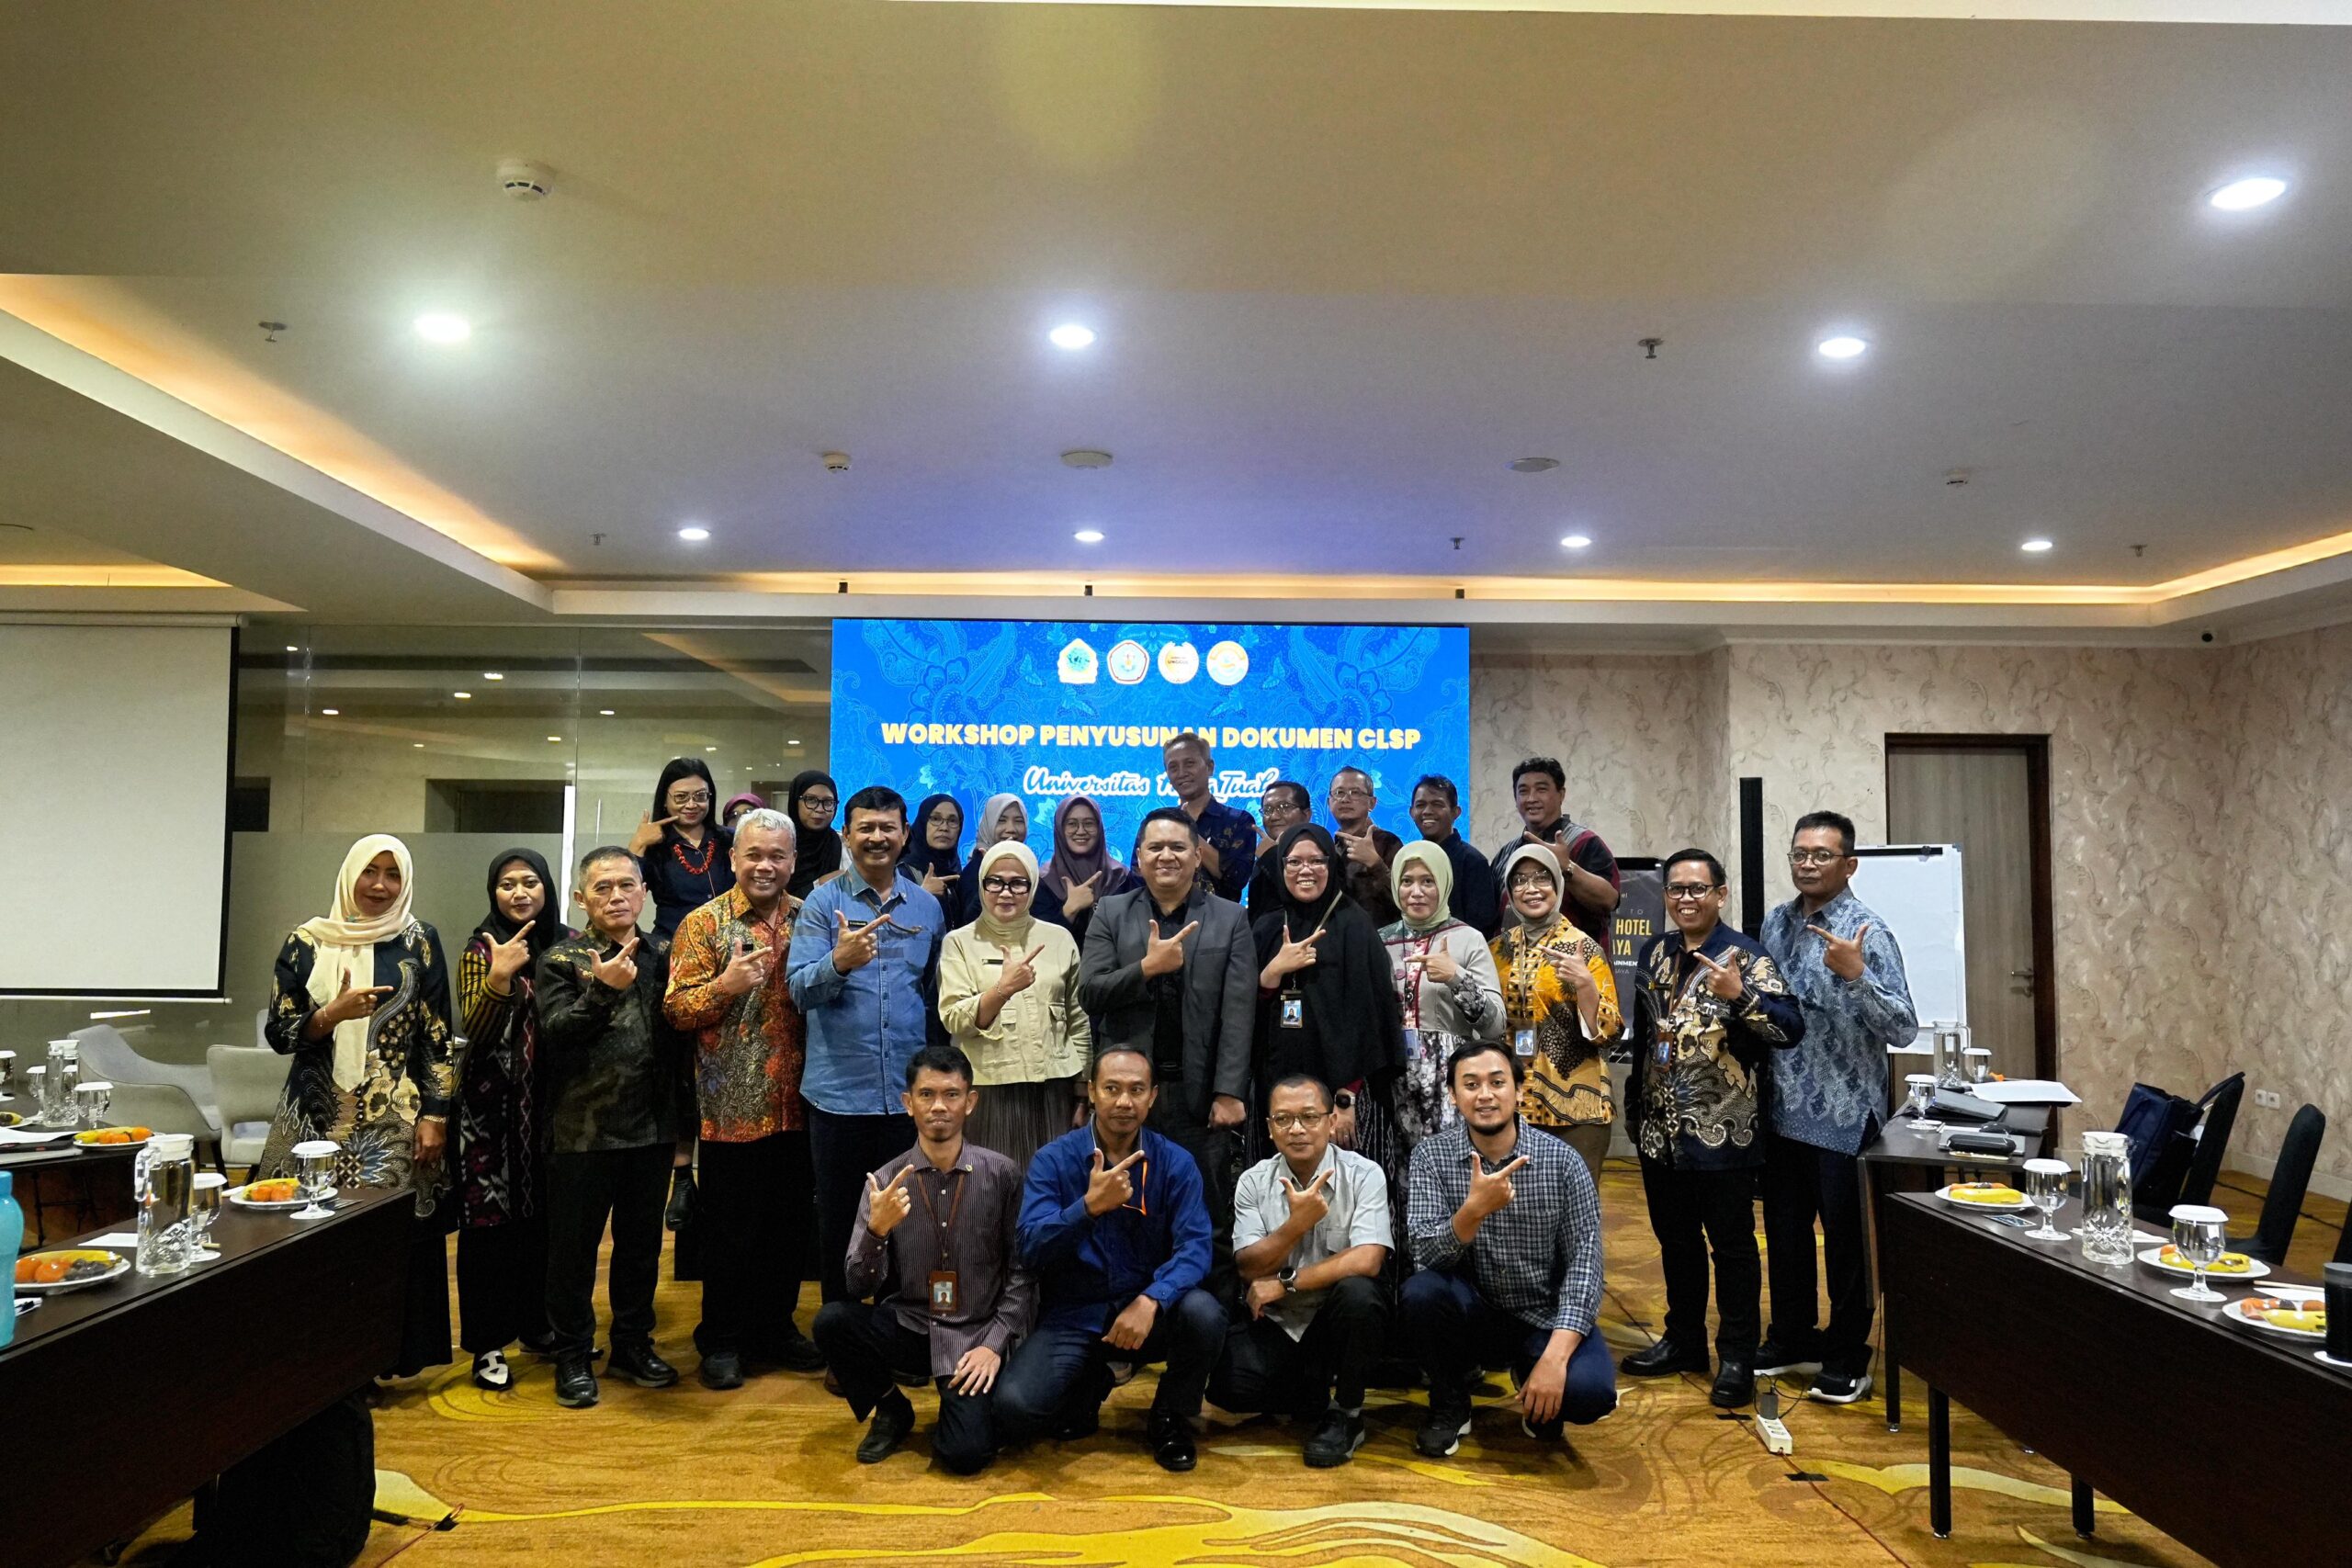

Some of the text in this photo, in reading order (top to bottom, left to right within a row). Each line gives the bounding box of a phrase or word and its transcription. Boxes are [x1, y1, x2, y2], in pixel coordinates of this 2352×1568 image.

[881, 722, 1421, 750] WORKSHOP PENYUSUNN DOKUMEN CLSP
[1023, 765, 1150, 795] Universitas
[1616, 919, 1652, 936] HOTEL
